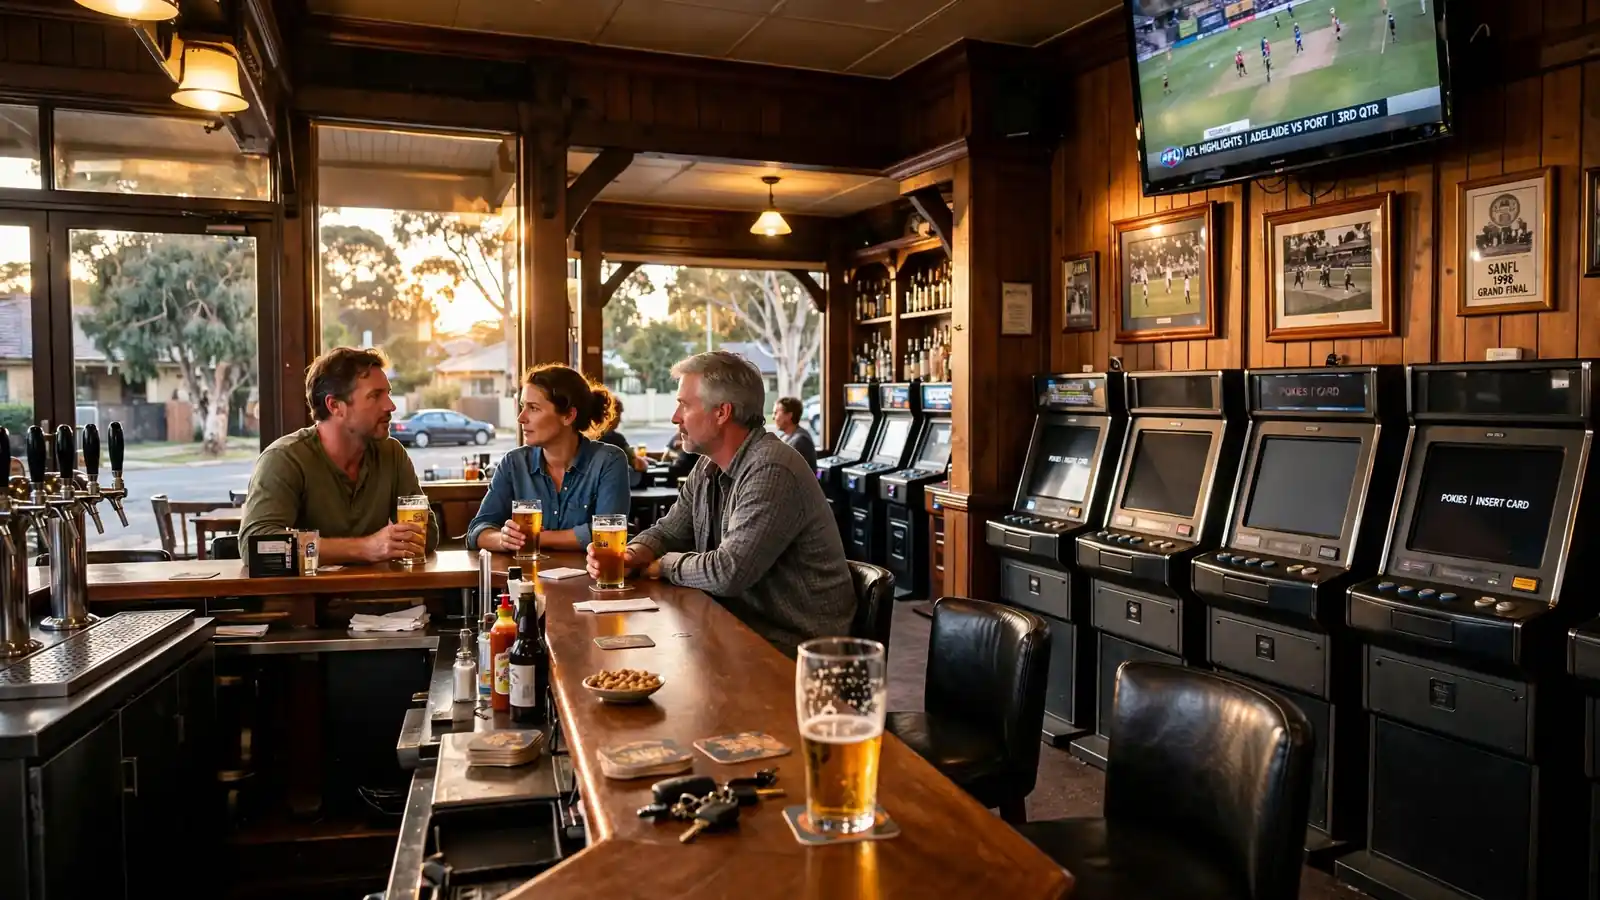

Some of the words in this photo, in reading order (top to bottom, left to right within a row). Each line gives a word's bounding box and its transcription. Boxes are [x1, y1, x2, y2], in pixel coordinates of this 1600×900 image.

[1185, 146, 1198, 158] AFL
[1199, 134, 1243, 155] HIGHLIGHTS
[1250, 124, 1290, 143] ADELAIDE
[1290, 122, 1303, 133] VS
[1304, 115, 1328, 131] PORT
[1337, 109, 1357, 123] 3RD
[1359, 103, 1379, 119] QTR
[1488, 261, 1519, 275] SANFL
[1493, 274, 1514, 285] 1998
[1478, 286, 1503, 297] GRAND
[1505, 283, 1528, 294] FINAL
[1441, 493, 1468, 504] POKIES
[1475, 496, 1505, 508] INSERT
[1506, 499, 1529, 509] CARD
